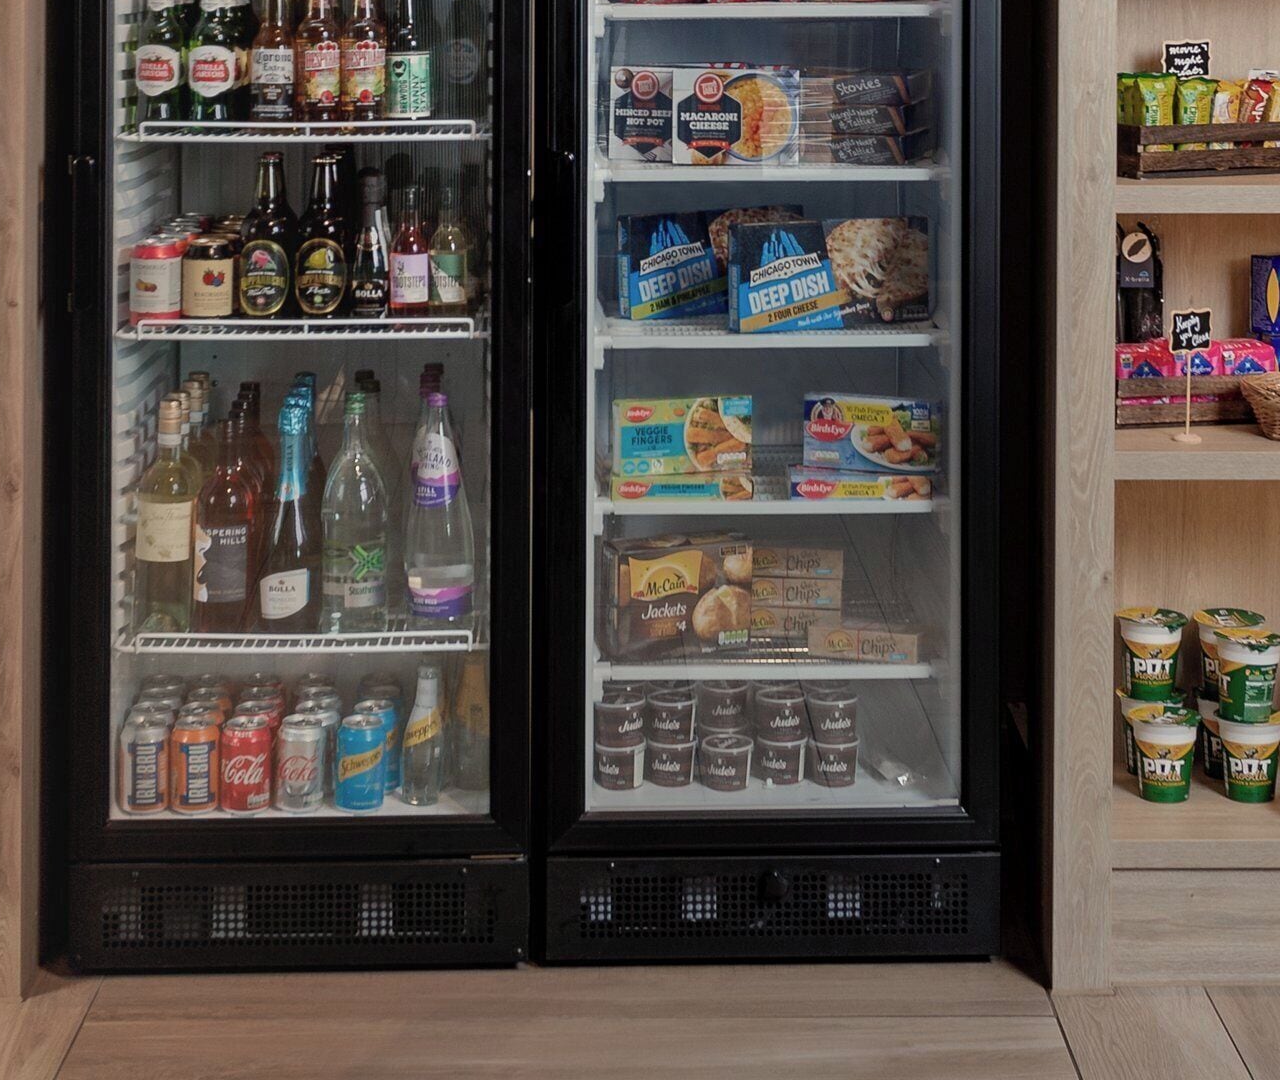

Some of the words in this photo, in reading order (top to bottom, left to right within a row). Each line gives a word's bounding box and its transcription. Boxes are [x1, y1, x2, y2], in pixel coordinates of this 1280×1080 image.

[836, 78, 881, 96] Stovies
[615, 108, 648, 117] MINCED
[680, 112, 738, 121] MACARONI
[689, 121, 730, 131] CHEESE
[641, 254, 678, 271] CHICAGO
[678, 246, 703, 261] TOWN
[752, 264, 789, 283] CHICAGO
[791, 255, 819, 269] TOWN
[638, 272, 677, 302] DEEP
[678, 259, 713, 290] DISH
[748, 282, 789, 314] DEEP
[790, 271, 831, 302] DISH
[774, 308, 792, 321] FOUR
[792, 300, 819, 316] CHEESE
[851, 414, 876, 422] OMEGA
[635, 427, 669, 437] VEGGIE
[631, 436, 673, 446] FINGERS
[220, 536, 247, 545] HILLS
[786, 556, 820, 571] Chips
[268, 584, 296, 593] BOLLA
[646, 578, 686, 595] McCain
[786, 586, 820, 602] Chips
[641, 603, 687, 620] Jackets
[861, 639, 896, 655] Chips
[1133, 658, 1173, 673] POT
[1143, 759, 1185, 775] POT
[1230, 759, 1271, 774] POT
